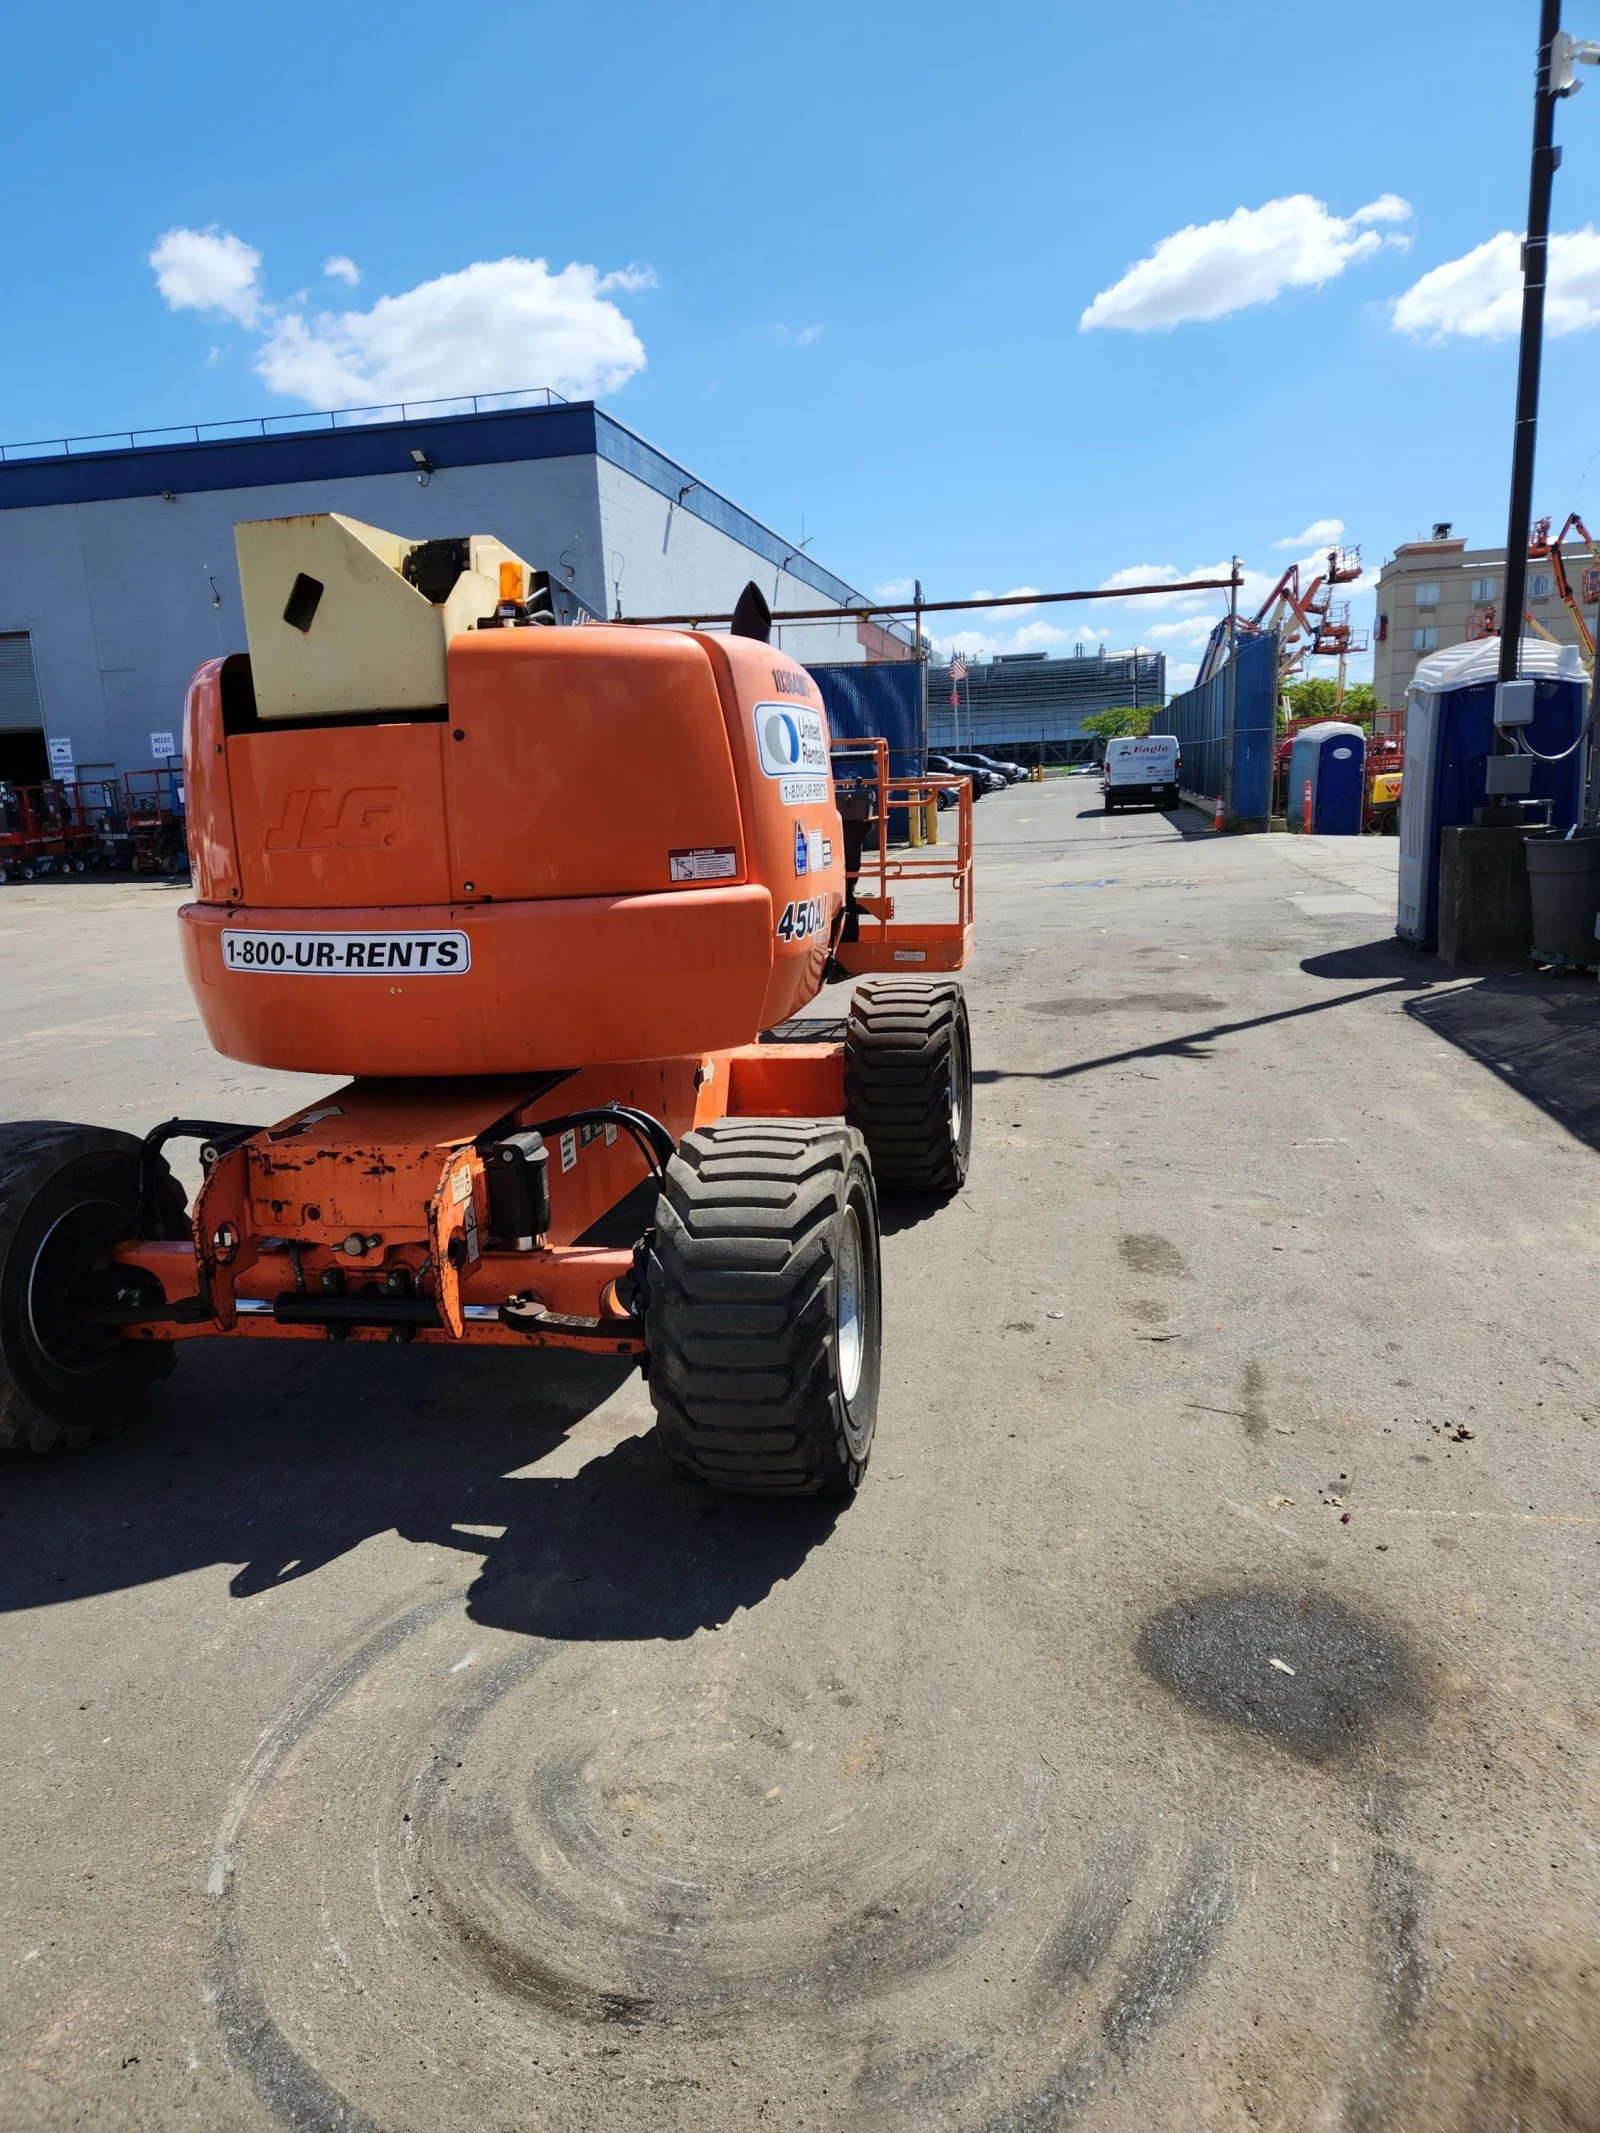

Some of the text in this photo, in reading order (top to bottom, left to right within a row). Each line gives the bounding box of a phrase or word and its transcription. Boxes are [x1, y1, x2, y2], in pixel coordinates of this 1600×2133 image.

[798, 716, 821, 742] United
[802, 742, 827, 765] Rentals
[1133, 745, 1168, 753] Eagle
[784, 783, 827, 799] 1-800-UR-RENTS
[265, 786, 398, 851] JLG
[777, 893, 828, 943] 450AJ
[227, 940, 459, 967] 1-800-UR-RENTS
